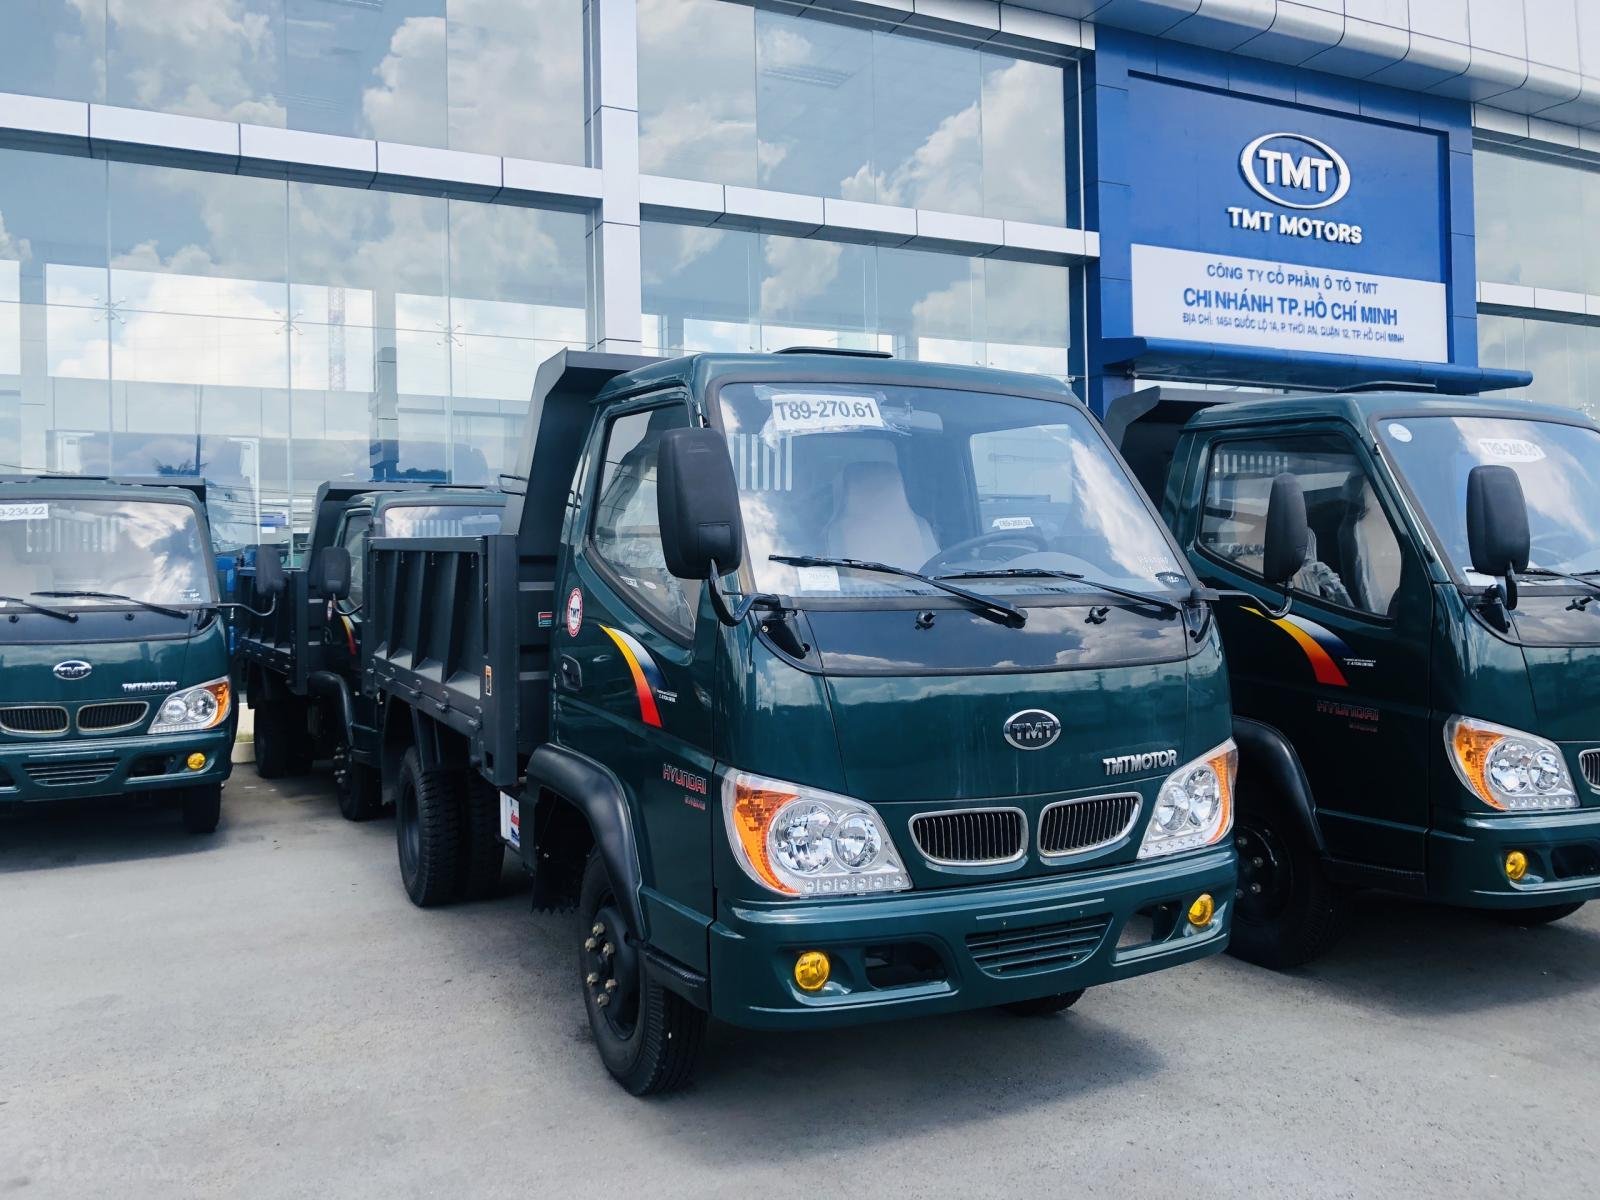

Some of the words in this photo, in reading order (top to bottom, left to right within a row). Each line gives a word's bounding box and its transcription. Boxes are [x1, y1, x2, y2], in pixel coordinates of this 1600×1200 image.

[1258, 149, 1334, 192] TMT
[1227, 206, 1274, 231] TMT
[1279, 214, 1363, 244] MOTORS
[1207, 263, 1243, 280] CÔNG
[1248, 268, 1264, 282] TY
[1267, 265, 1284, 285] CỔ
[1287, 270, 1320, 289] PHẦN
[1324, 274, 1332, 290] Ô
[1336, 277, 1351, 292] TÔ
[1355, 281, 1379, 295] TMT
[1183, 287, 1212, 309] CHI
[1215, 288, 1274, 314] NHÁNH
[1304, 293, 1327, 319] HỒ
[1331, 300, 1357, 322] CHÍ
[1360, 307, 1398, 326] MINH
[774, 400, 875, 421] T89-270.61
[1011, 721, 1054, 740] TMT
[663, 763, 707, 794] HYUNDAI
